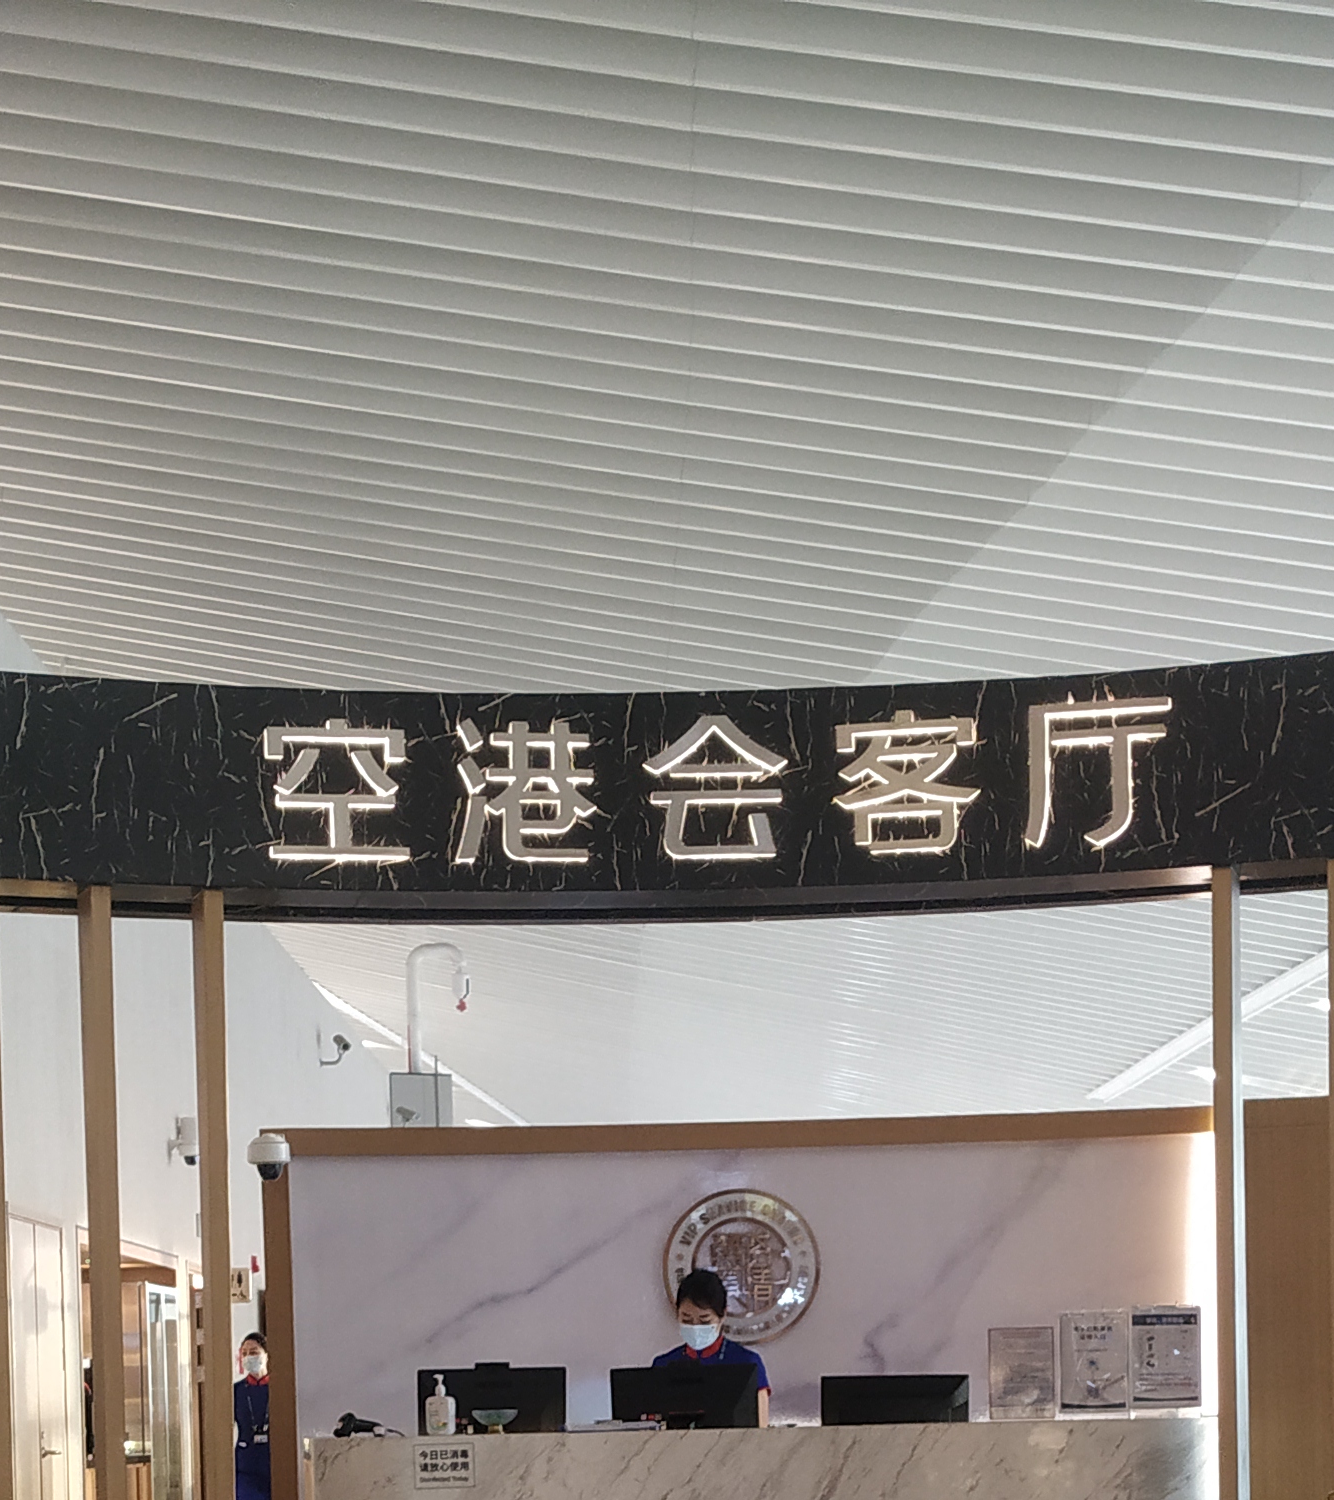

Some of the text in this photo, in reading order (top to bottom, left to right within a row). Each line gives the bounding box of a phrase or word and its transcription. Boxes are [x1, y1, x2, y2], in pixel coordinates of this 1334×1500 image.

[263, 695, 1174, 865] 空港会客厅
[419, 1449, 469, 1460] 今日已消毒
[419, 1461, 470, 1472] 请放心使用
